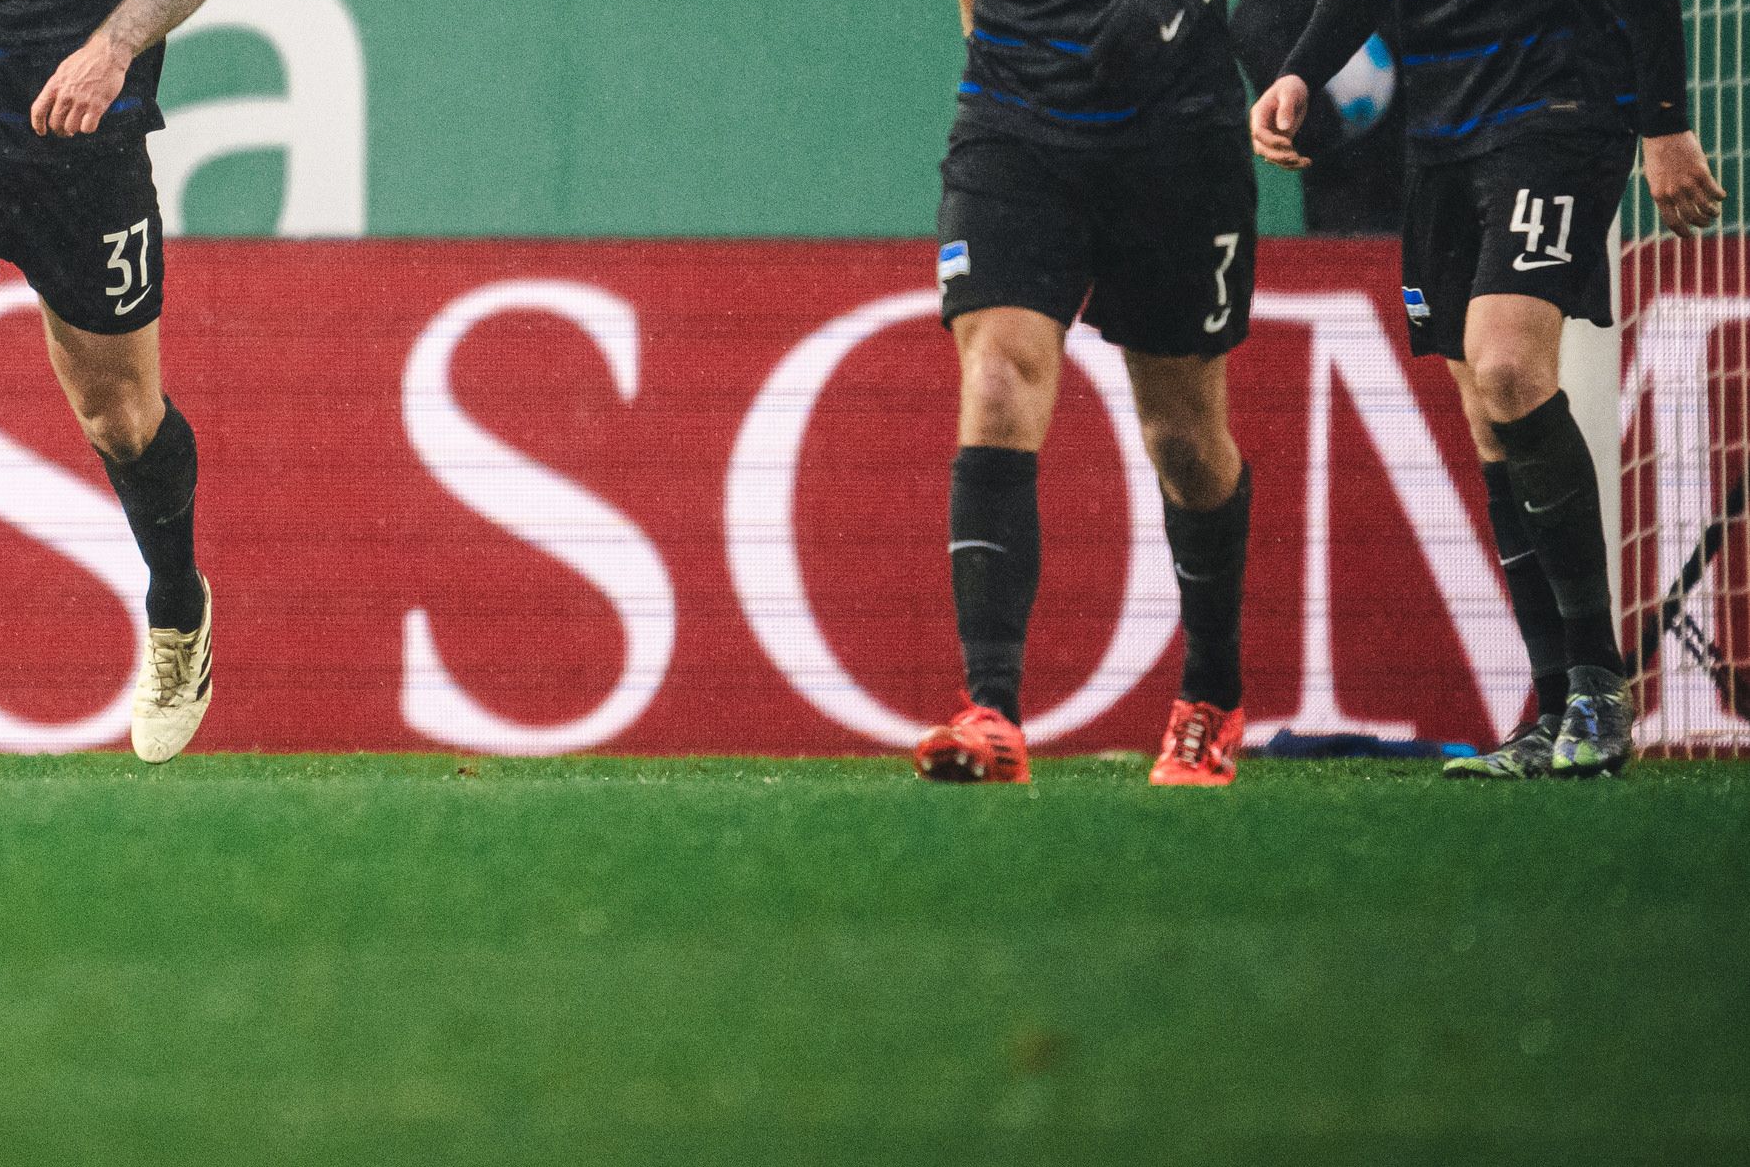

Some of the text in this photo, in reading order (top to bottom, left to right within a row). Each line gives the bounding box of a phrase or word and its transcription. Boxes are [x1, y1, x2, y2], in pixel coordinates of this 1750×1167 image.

[103, 218, 148, 296] 37
[1509, 189, 1574, 262] 41
[1214, 233, 1239, 305] 7
